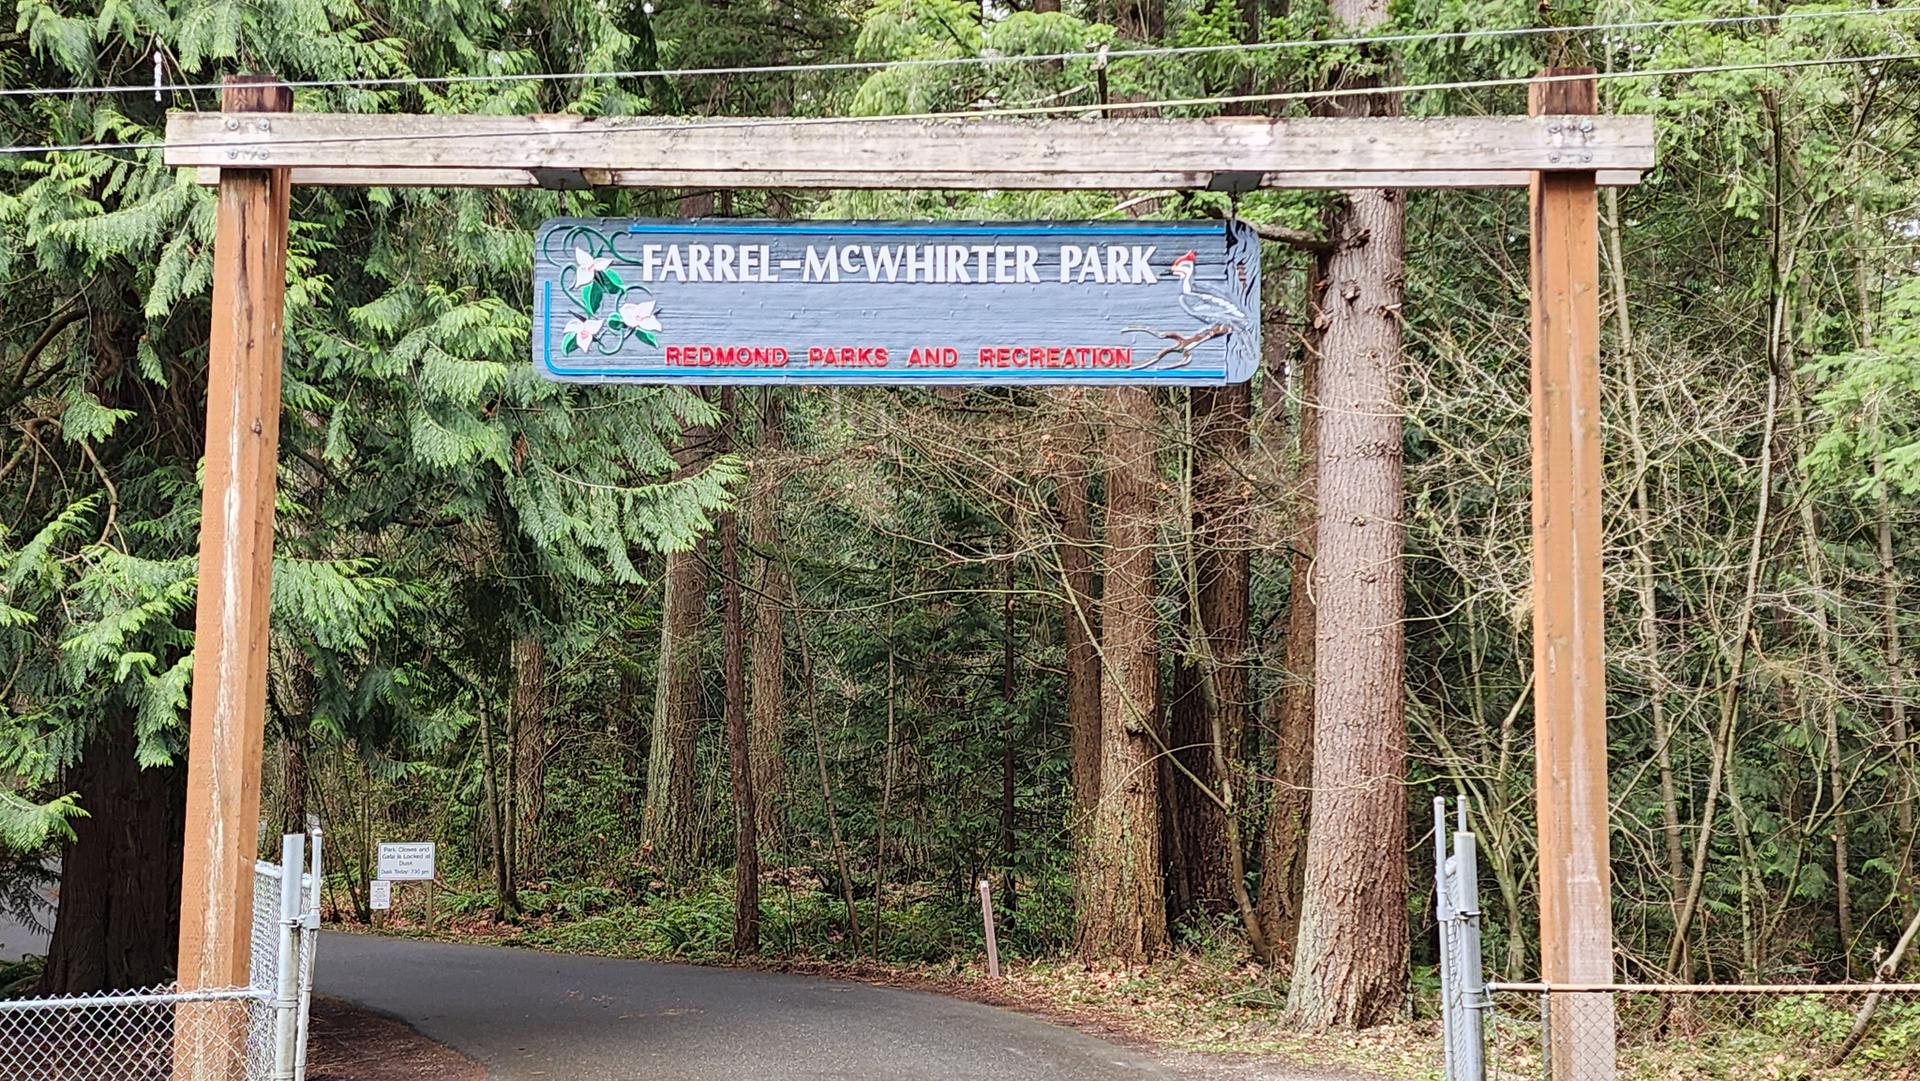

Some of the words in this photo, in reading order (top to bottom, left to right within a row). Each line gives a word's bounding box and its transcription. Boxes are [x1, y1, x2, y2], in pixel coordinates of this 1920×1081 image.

[1060, 245, 1158, 284] PARK
[665, 346, 789, 367] REDMOND
[807, 346, 889, 368] PARKS
[907, 346, 959, 368] AND
[978, 346, 1132, 368] RECREATION
